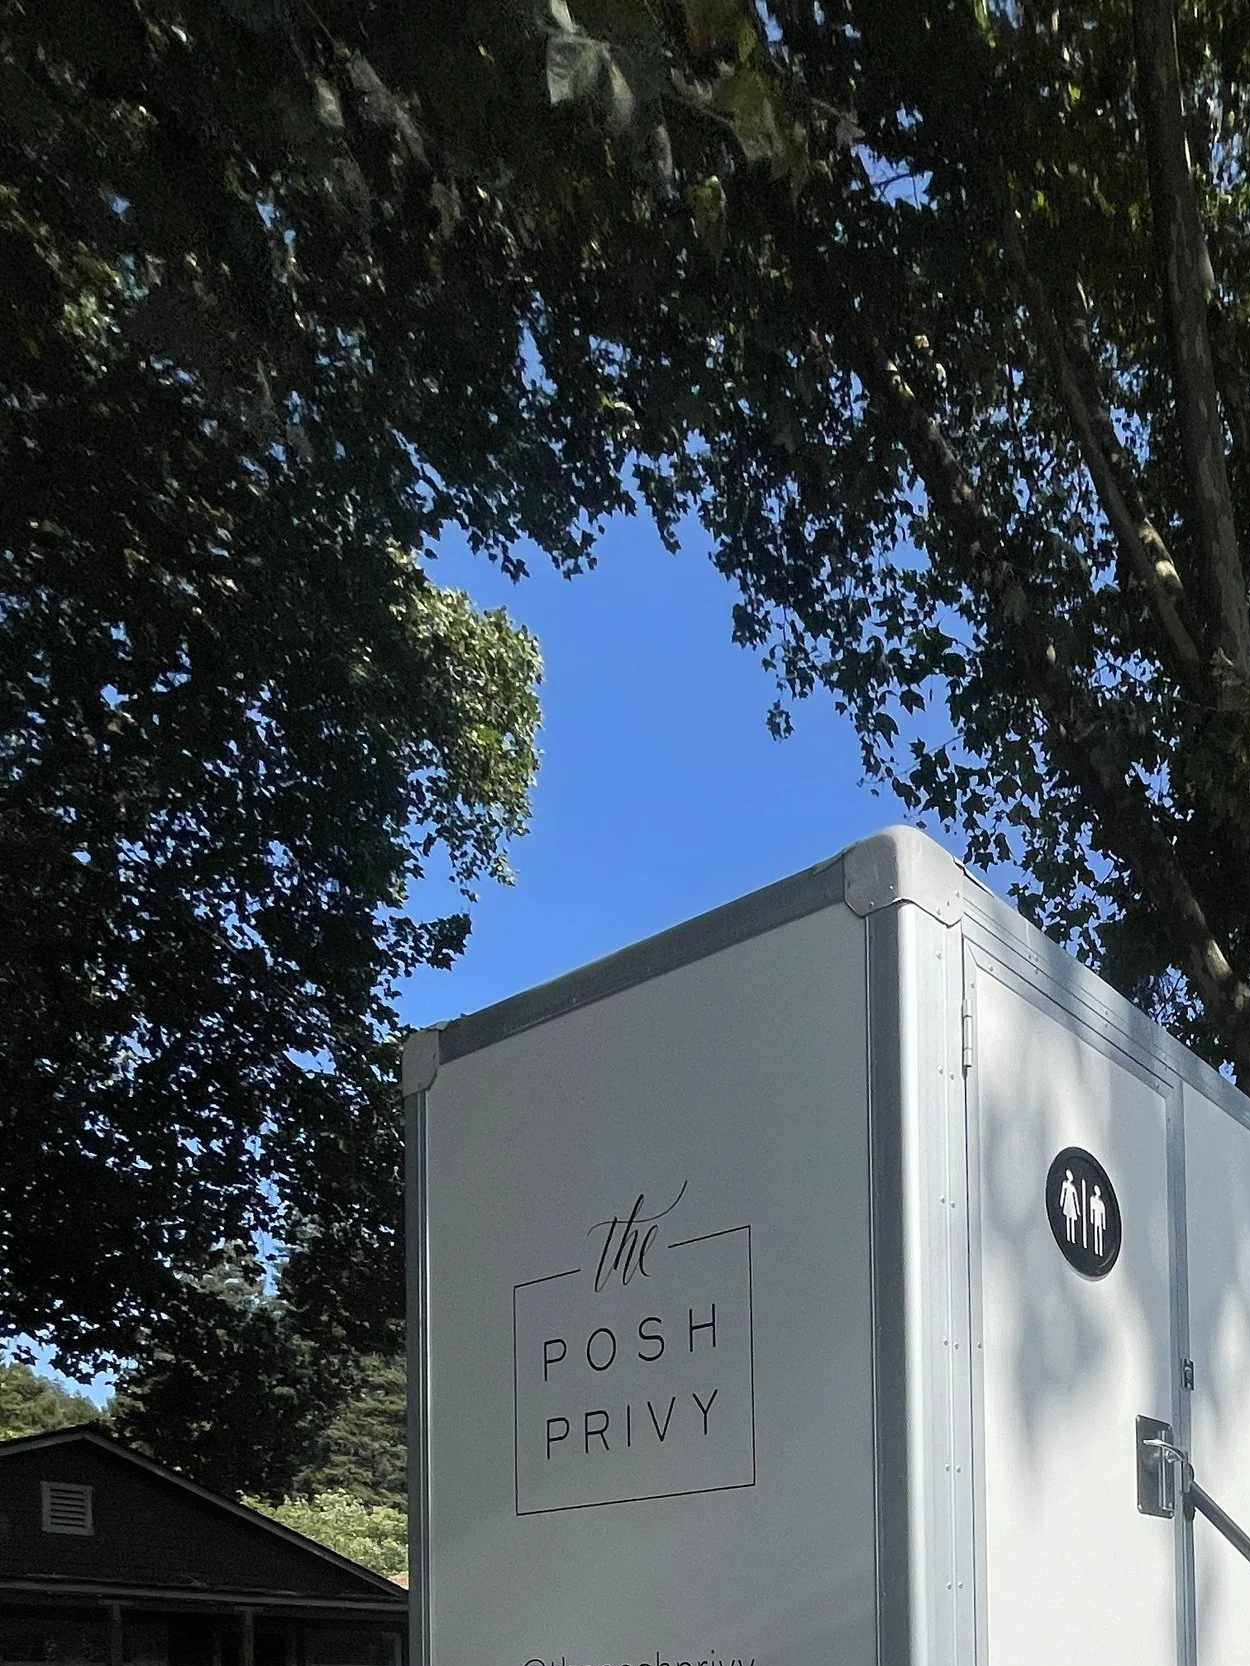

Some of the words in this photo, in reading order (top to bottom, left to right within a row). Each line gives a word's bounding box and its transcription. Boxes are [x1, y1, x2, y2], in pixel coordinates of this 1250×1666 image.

[586, 1179, 689, 1294] the
[543, 1302, 717, 1383] POSH
[546, 1388, 719, 1460] PRIVY
